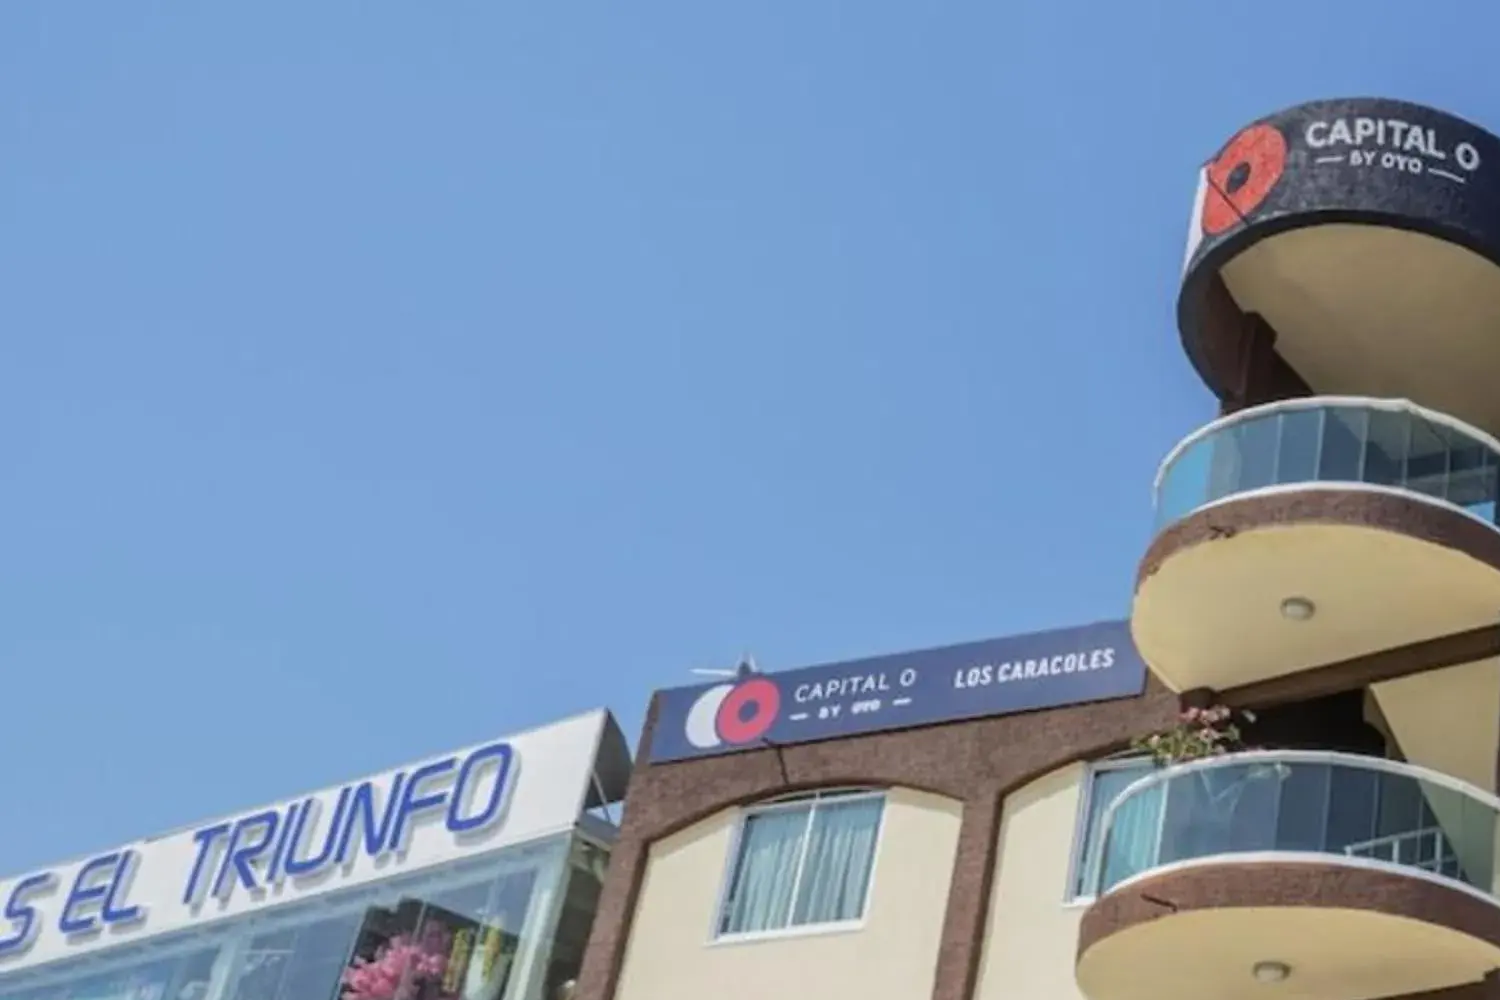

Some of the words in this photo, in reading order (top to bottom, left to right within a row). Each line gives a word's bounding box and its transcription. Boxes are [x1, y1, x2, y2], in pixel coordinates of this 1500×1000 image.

[1305, 117, 1446, 159] CAPITAL
[1454, 141, 1481, 172] O
[1349, 149, 1375, 167] BY
[1380, 151, 1424, 176] OYO
[794, 672, 891, 704] CAPITAL
[899, 667, 917, 687] O
[953, 666, 994, 690] LOS
[997, 647, 1116, 683] CARACOLES
[817, 703, 842, 720] BY
[59, 850, 140, 934] EL
[182, 742, 514, 905] TRIUNFO
